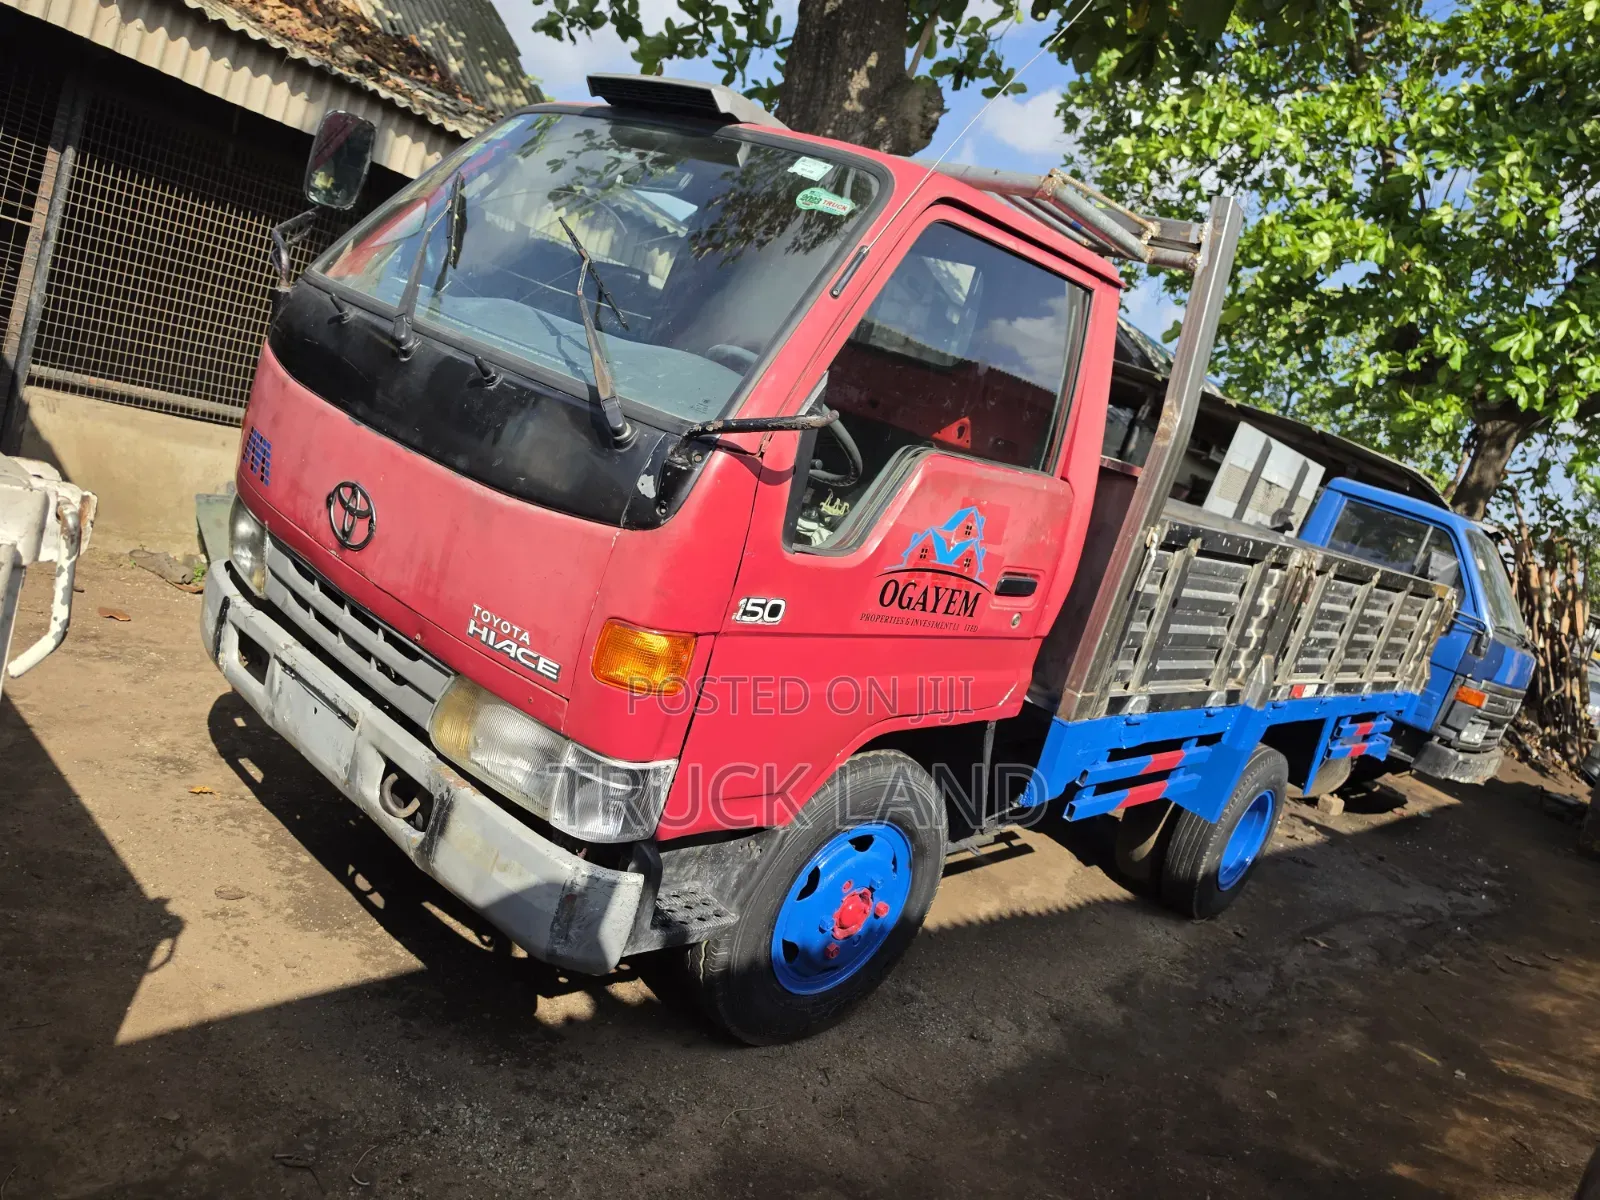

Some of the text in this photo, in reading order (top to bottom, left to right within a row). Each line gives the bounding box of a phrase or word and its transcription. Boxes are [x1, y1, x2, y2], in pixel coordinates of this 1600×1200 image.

[823, 200, 848, 211] TRUCK
[733, 597, 786, 624] 150
[878, 579, 981, 618] OGAYEM
[473, 603, 531, 646] TOYOTA
[860, 612, 904, 625] PROPERTIES
[911, 618, 953, 631] INVESTMENT
[467, 618, 562, 683] HIACE
